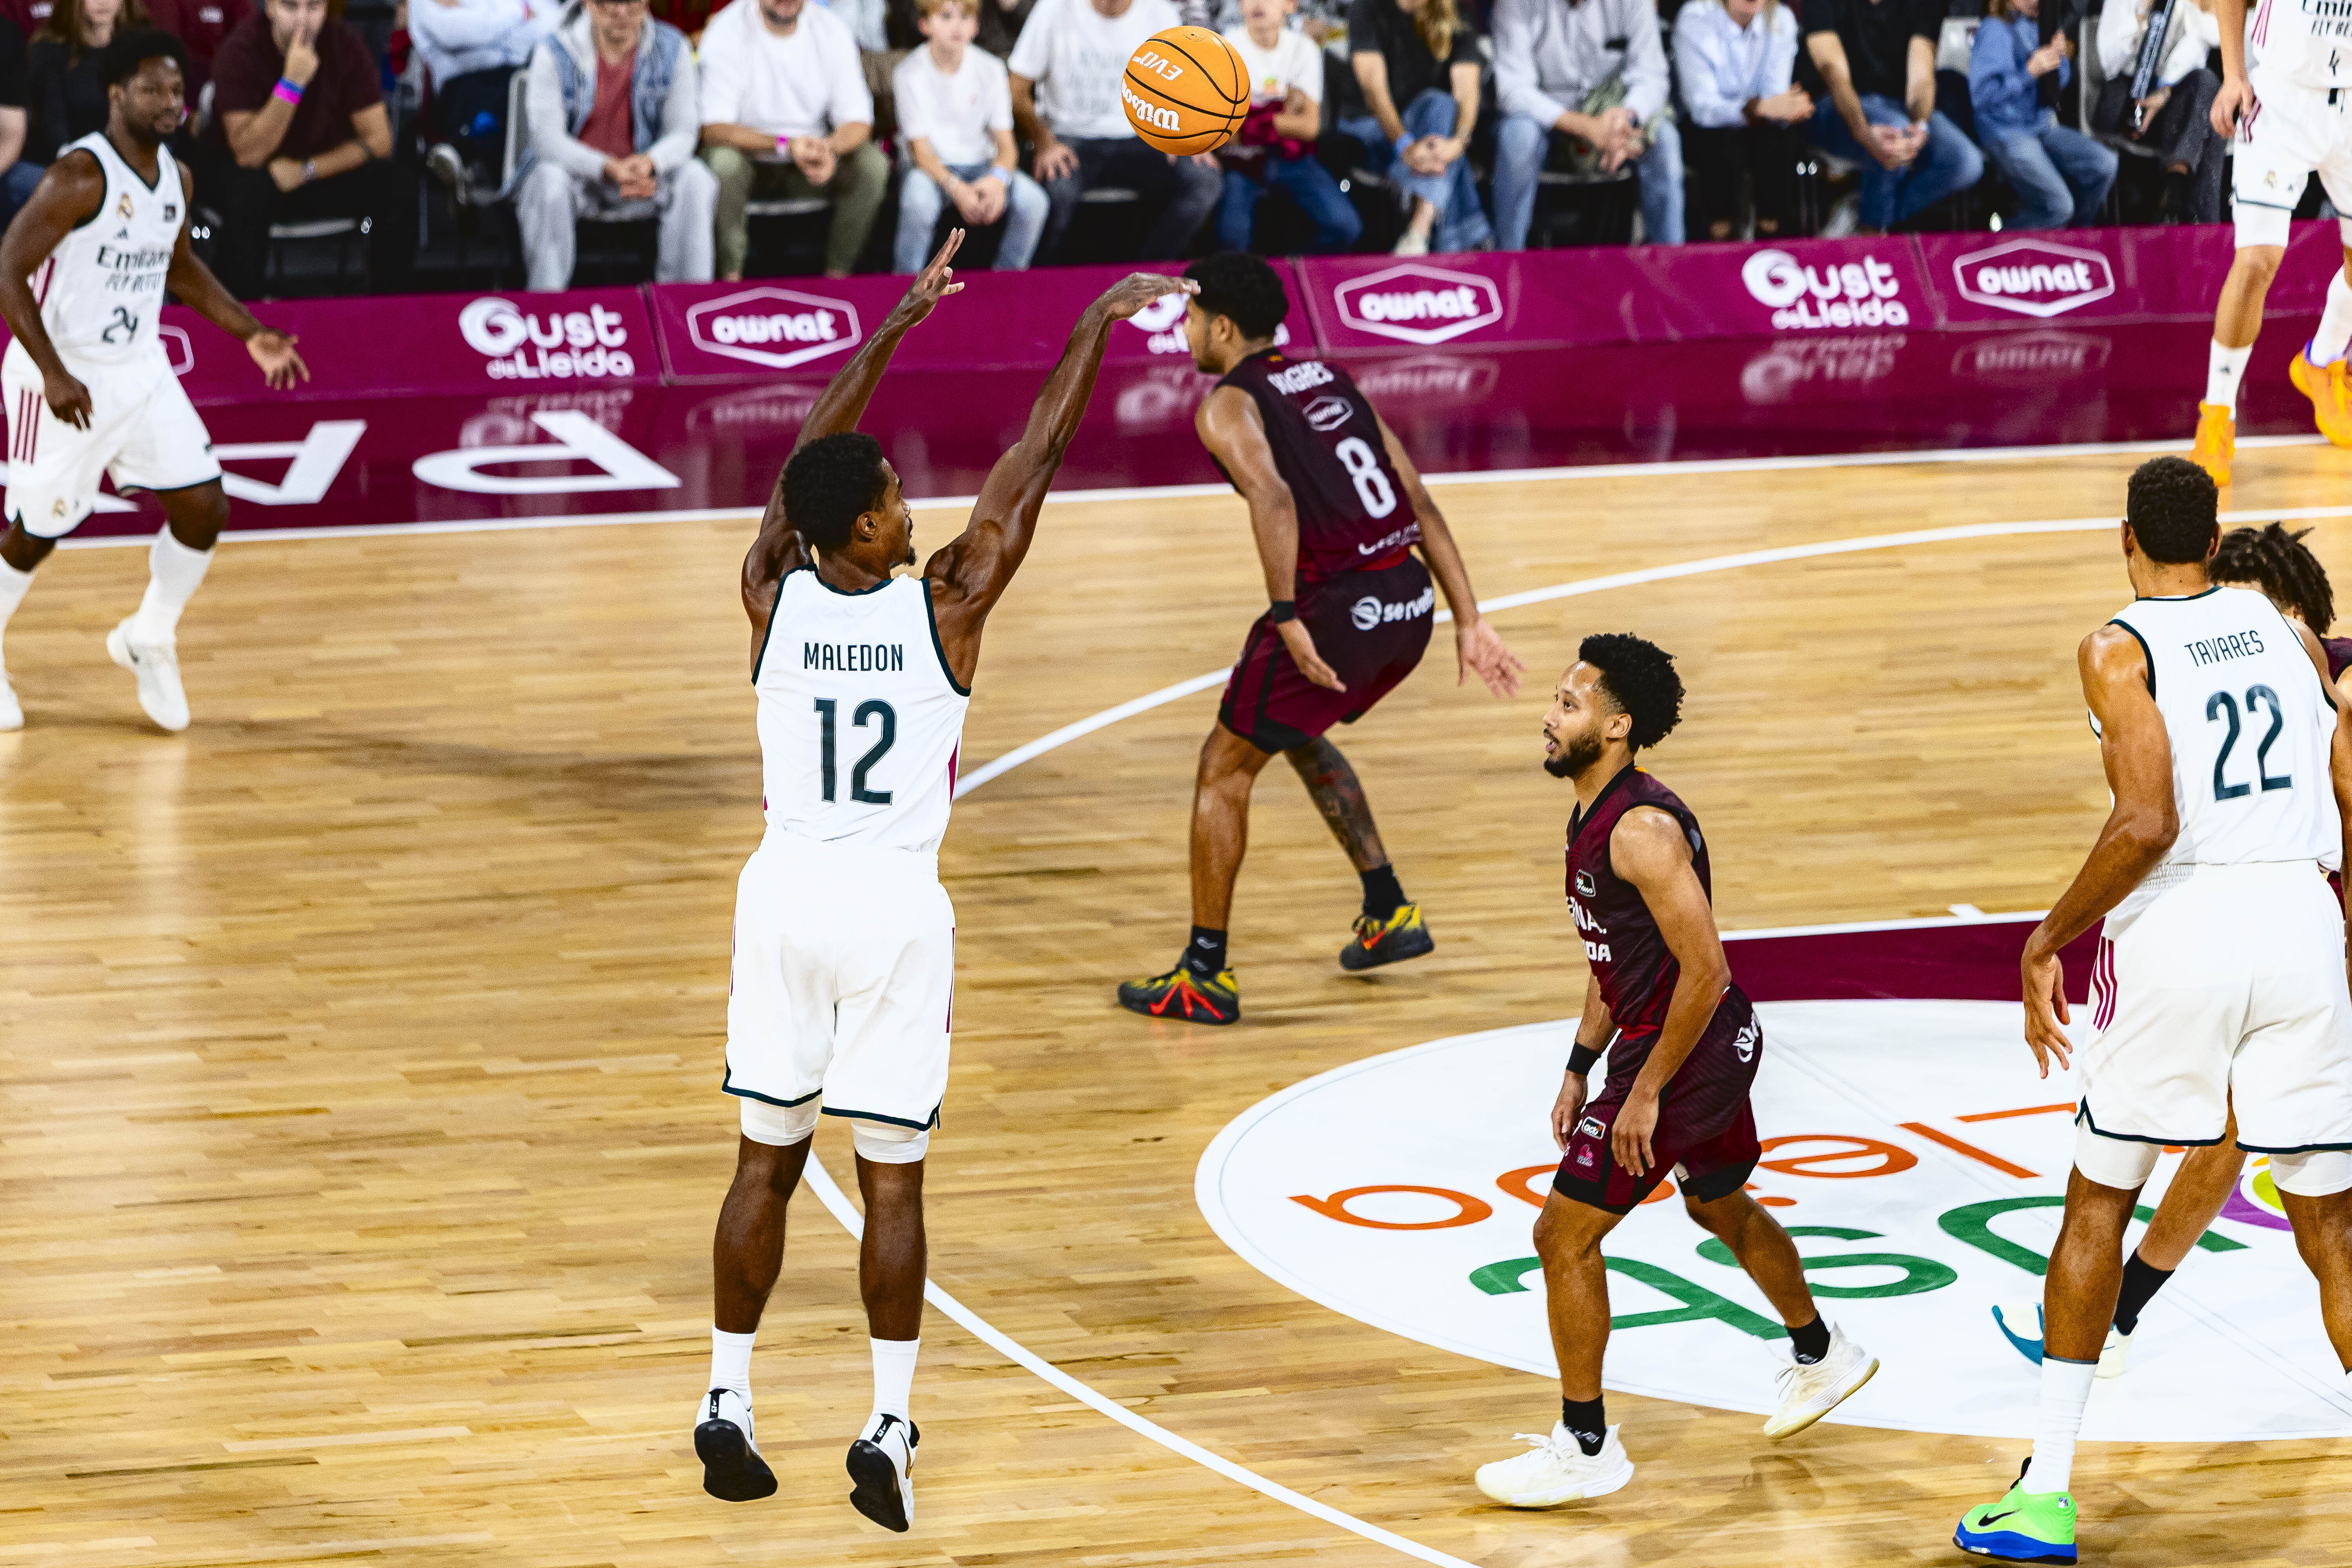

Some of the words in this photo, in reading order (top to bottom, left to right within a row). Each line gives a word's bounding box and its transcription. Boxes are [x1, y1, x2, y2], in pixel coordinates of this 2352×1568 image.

[1140, 51, 1183, 80] EVO
[2329, 47, 2339, 76] 4
[1122, 78, 1180, 131] Wilson
[1742, 249, 1899, 308] Gust
[1978, 261, 2092, 294] ownat
[1359, 286, 1479, 321] ownat
[1799, 296, 1909, 328] Lleida
[101, 305, 138, 344] 24
[458, 296, 626, 356] Gust
[712, 308, 837, 344] ownat
[514, 347, 634, 379] Lleida
[1335, 436, 1397, 519] 8
[804, 642, 903, 671] MALEDON
[2184, 630, 2265, 666] TAVARES
[814, 697, 897, 805] 12
[2205, 684, 2293, 803] 22
[1584, 1123, 1598, 1136] acb
